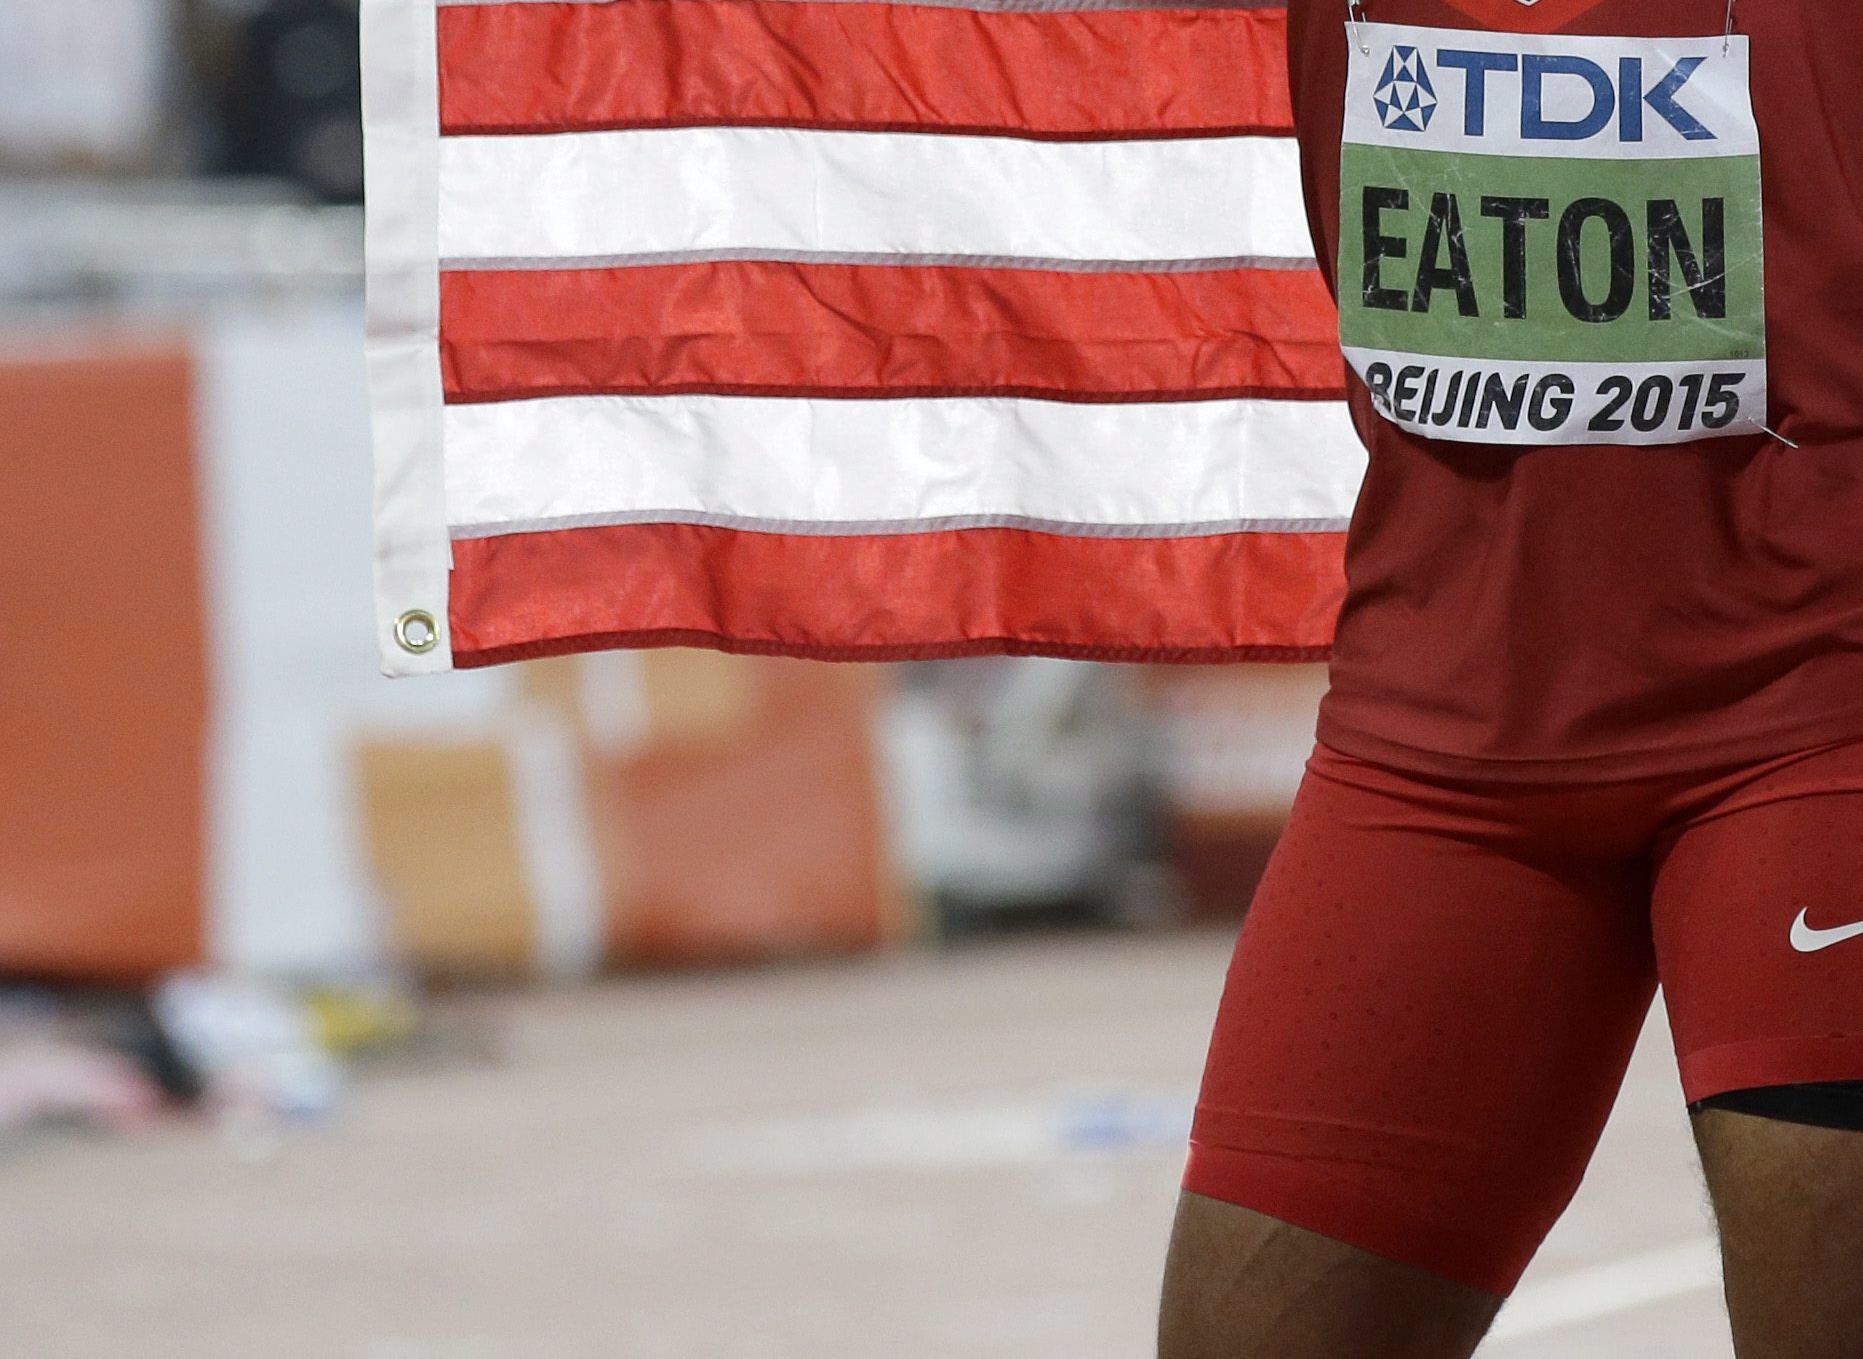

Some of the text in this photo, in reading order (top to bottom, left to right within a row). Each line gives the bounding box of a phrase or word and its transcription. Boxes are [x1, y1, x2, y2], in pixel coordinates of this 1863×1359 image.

[1436, 49, 1718, 142] TDK
[1362, 185, 1726, 323] EATON
[1365, 361, 1747, 433] BEIJING 2015
